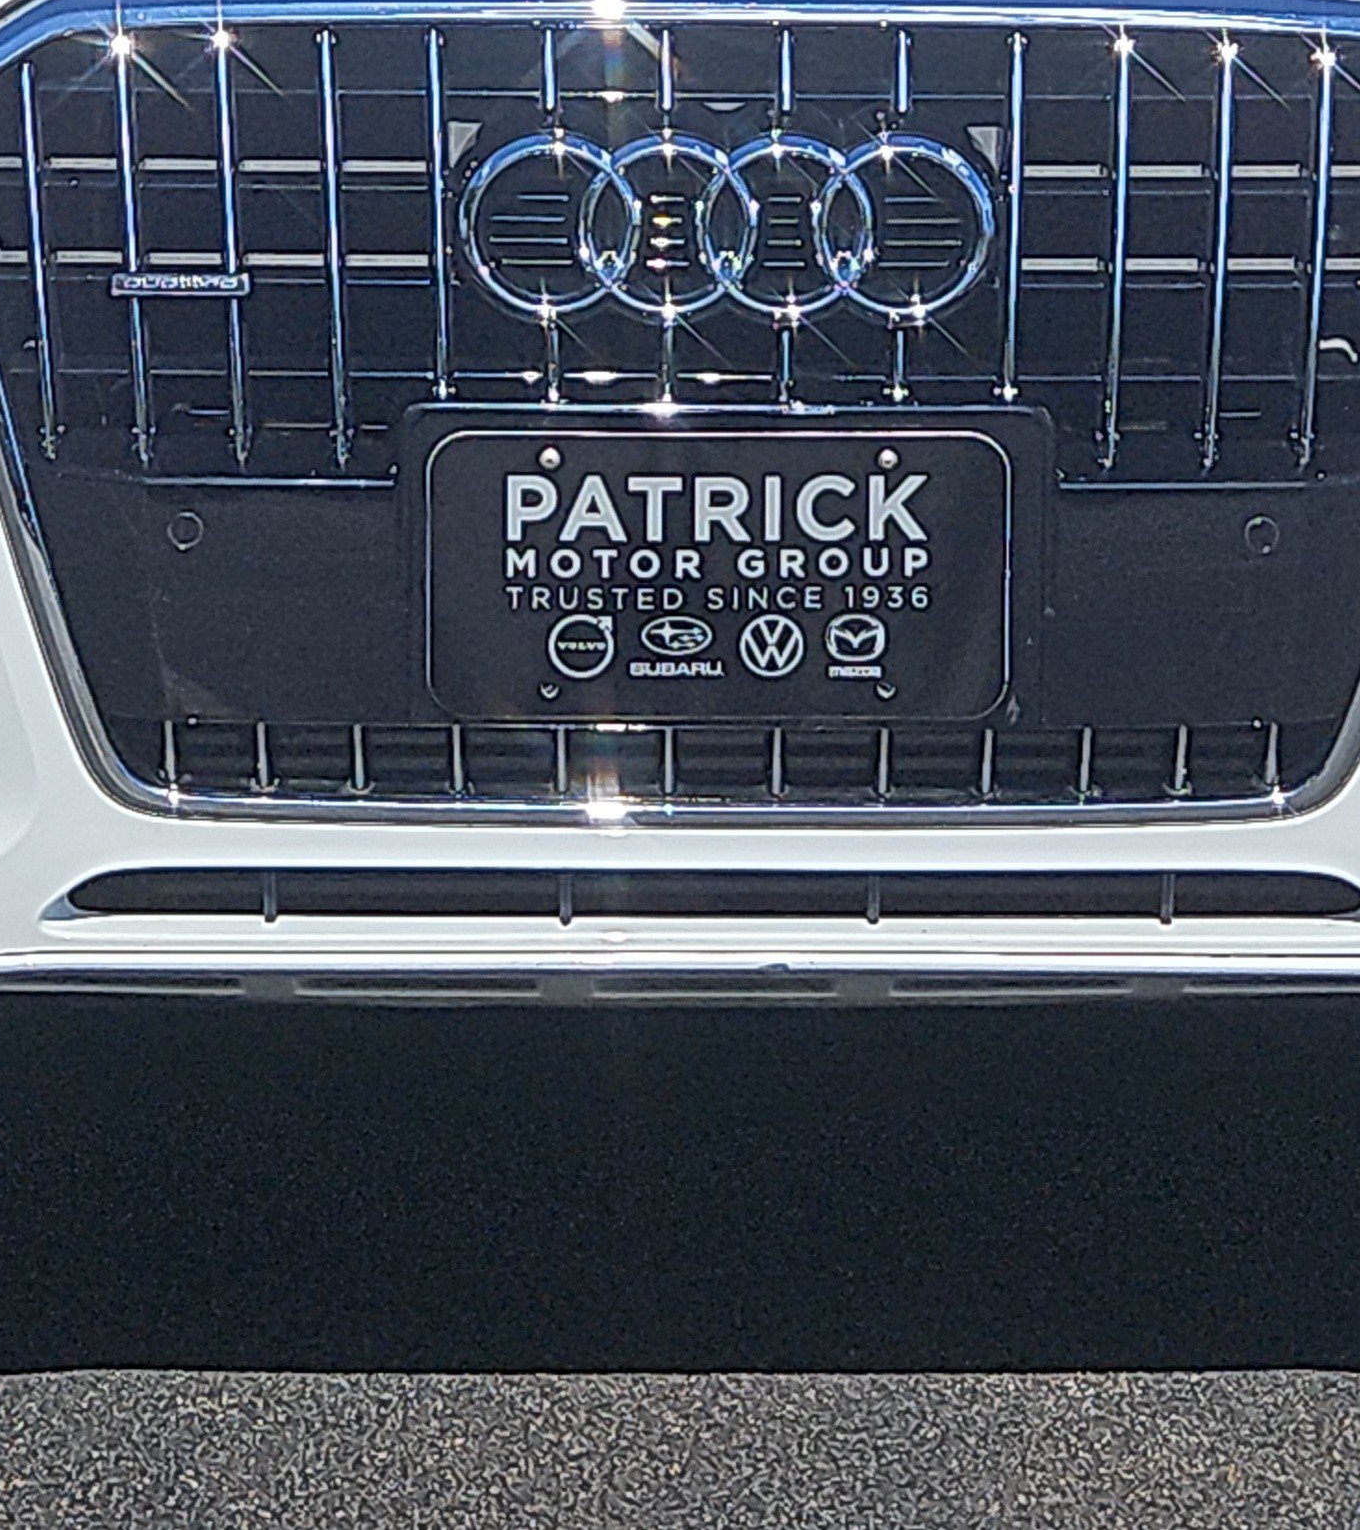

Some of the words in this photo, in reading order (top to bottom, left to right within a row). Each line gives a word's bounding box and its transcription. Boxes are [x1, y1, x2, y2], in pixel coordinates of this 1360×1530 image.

[506, 474, 928, 542] PATRICK
[506, 547, 701, 579] MOTOR
[737, 547, 928, 578] GROUP
[506, 586, 683, 610] TRUSTED
[707, 586, 822, 610] SINCE
[845, 586, 928, 608] 1936
[629, 661, 724, 677] SUBARU
